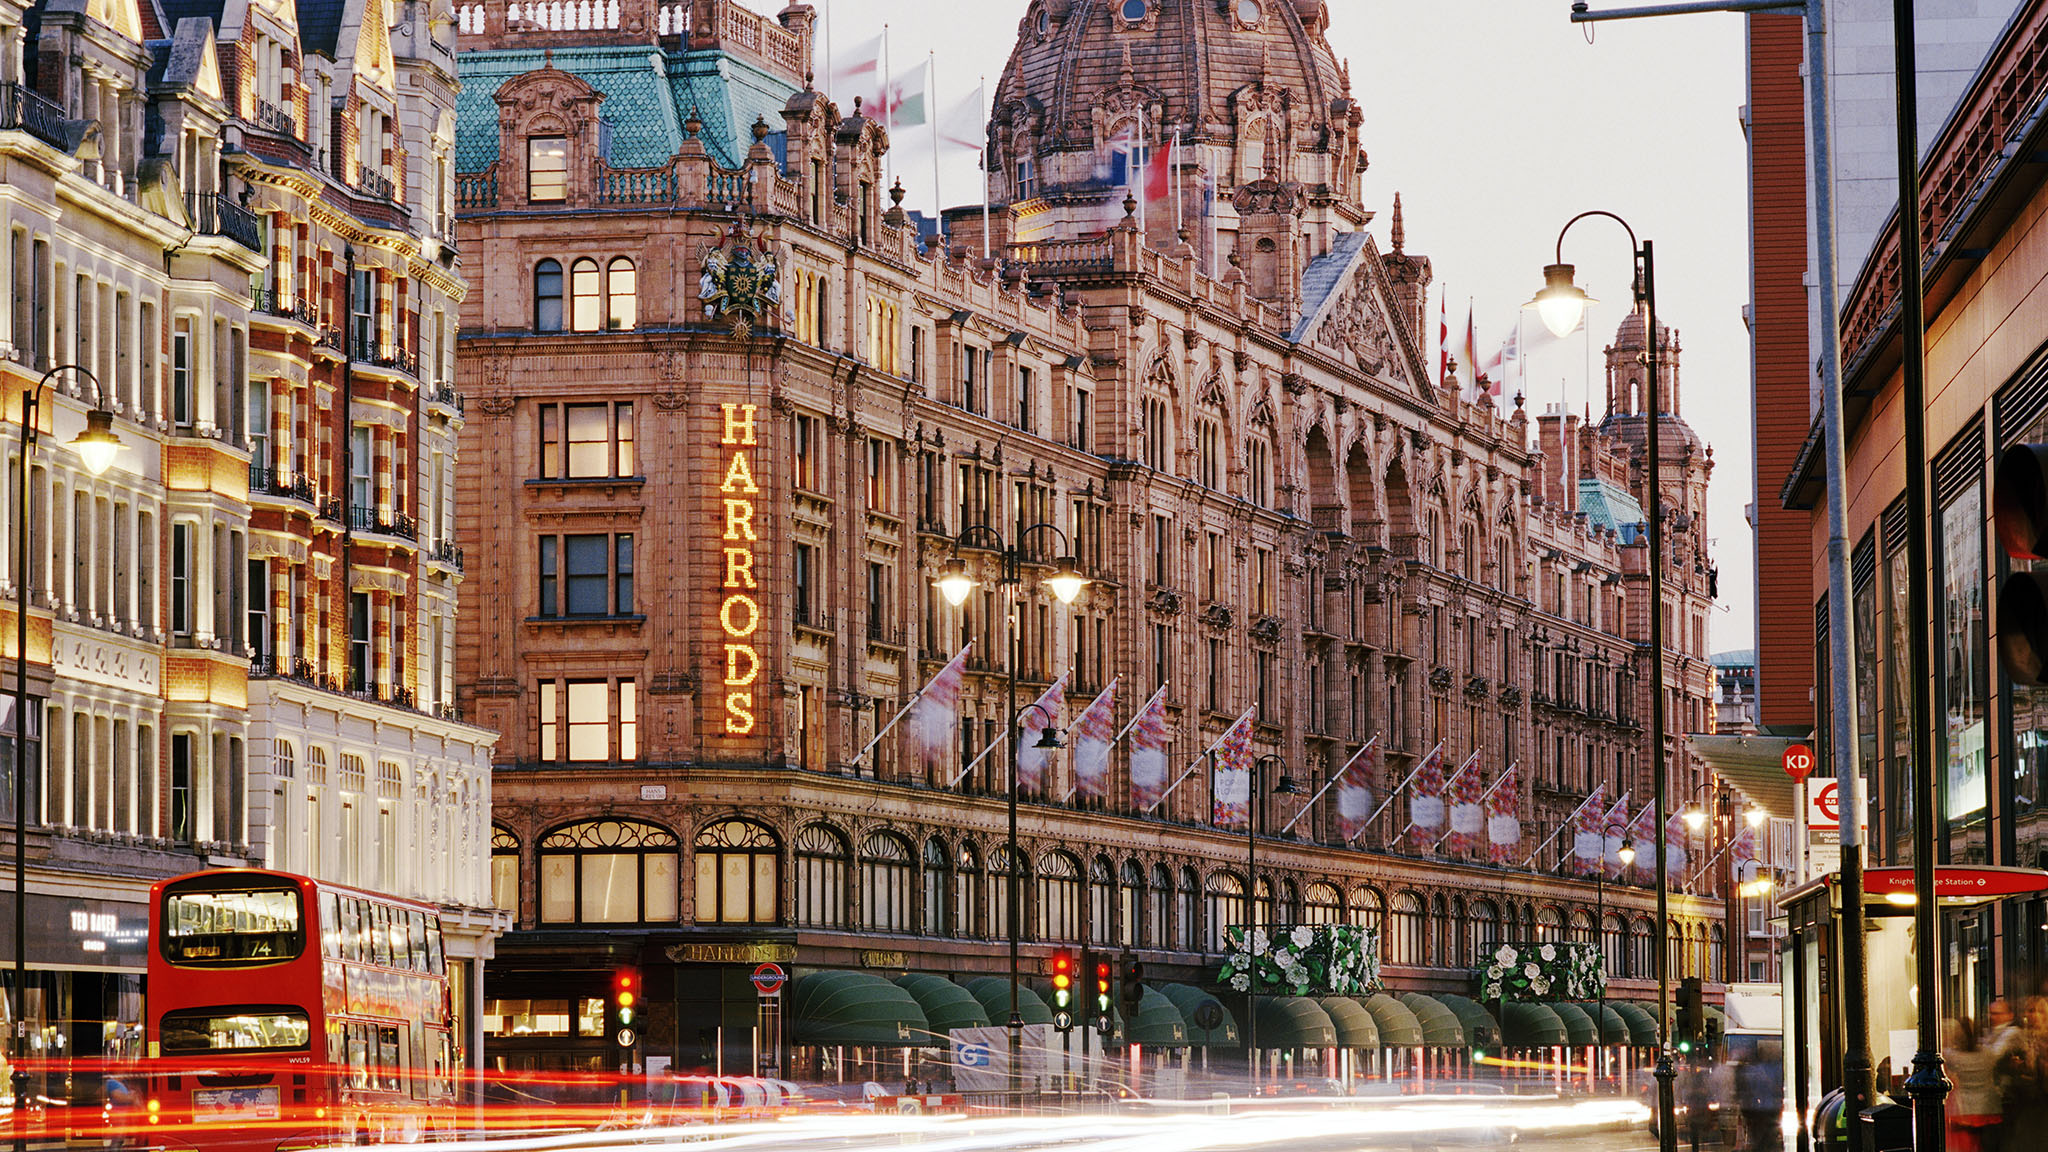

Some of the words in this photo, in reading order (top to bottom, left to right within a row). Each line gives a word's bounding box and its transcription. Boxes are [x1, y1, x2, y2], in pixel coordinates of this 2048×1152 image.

[720, 402, 760, 735] HARRODS
[1786, 755, 1810, 769] KD
[1945, 878, 1974, 886] Station
[70, 911, 88, 932] TED
[90, 913, 117, 932] BAKER
[250, 941, 272, 957] 74
[691, 945, 771, 961] HARRODS
